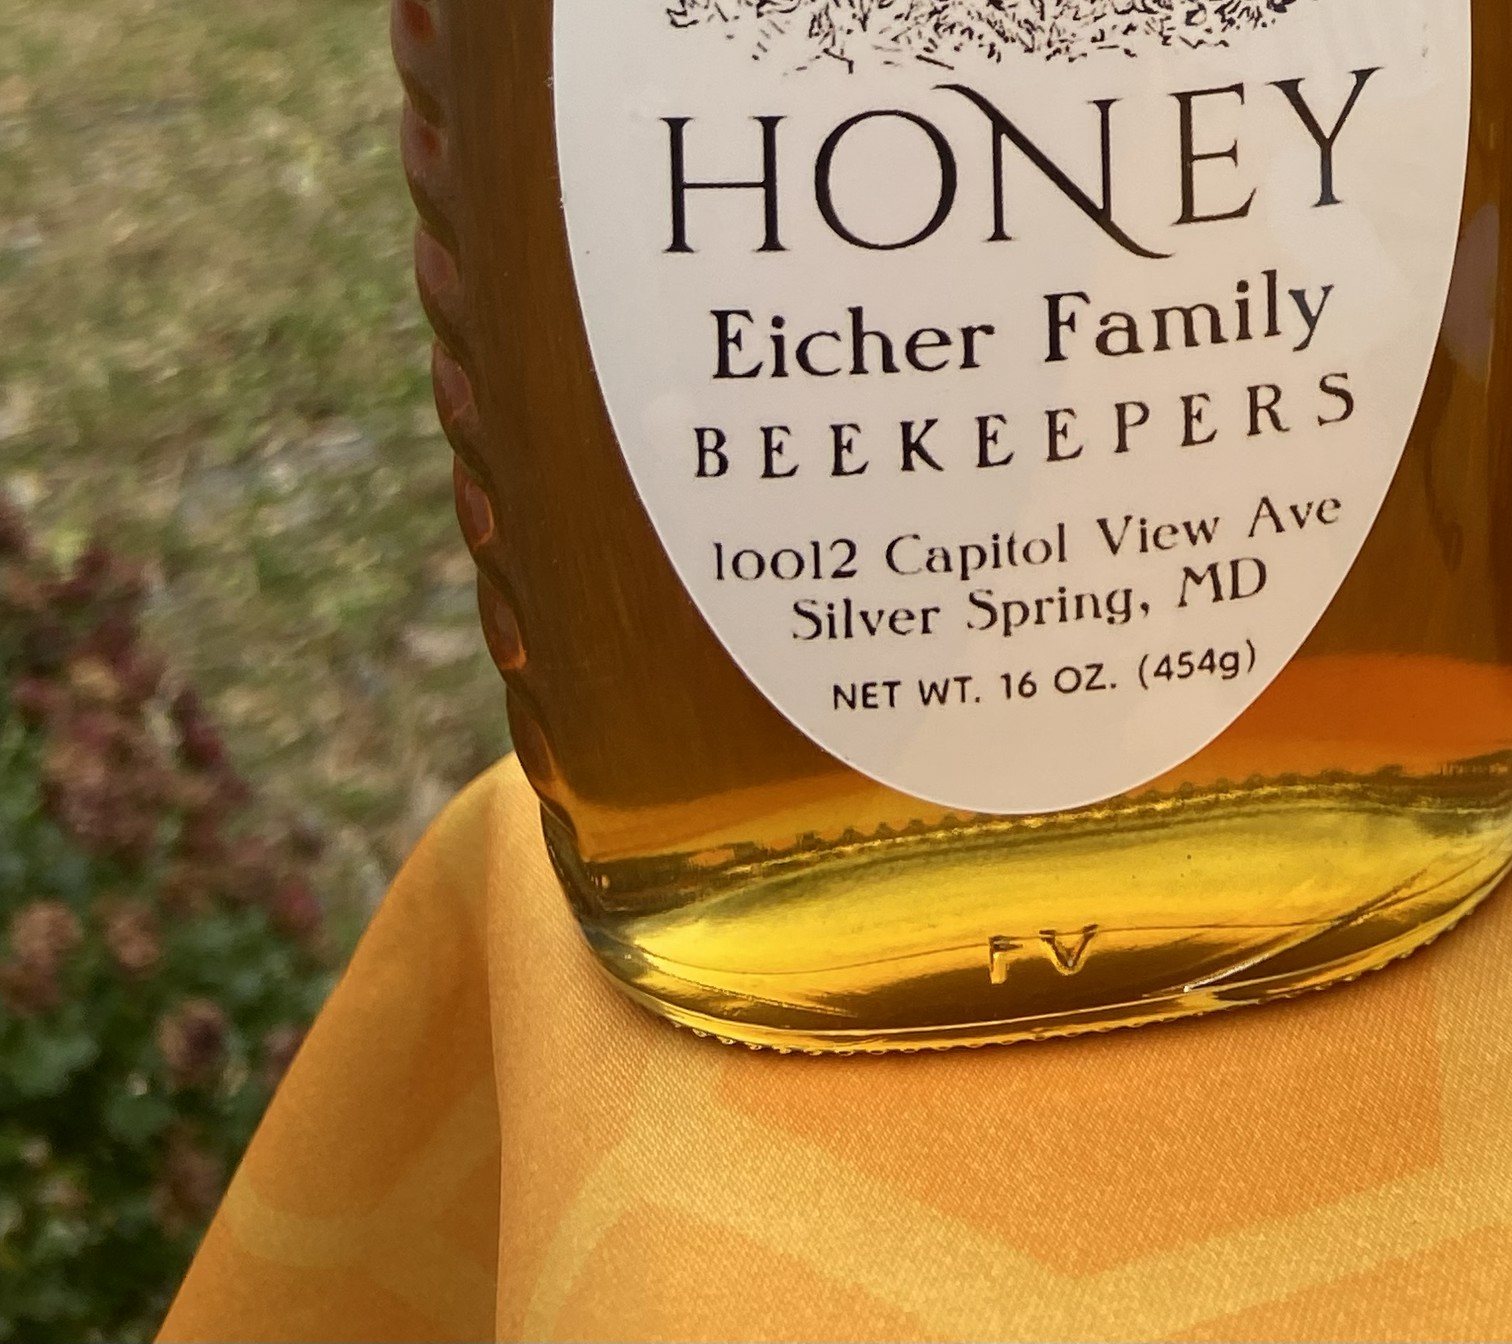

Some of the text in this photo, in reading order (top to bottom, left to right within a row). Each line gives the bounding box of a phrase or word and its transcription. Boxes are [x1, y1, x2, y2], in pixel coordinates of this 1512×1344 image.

[658, 65, 1382, 261] HONEY
[708, 268, 1336, 381] Eicher Family
[692, 371, 1355, 480] BEEKEEPERS
[712, 495, 1343, 583] 10012 Capitol View Ave
[791, 557, 1268, 642] Silver Spring, MD
[832, 638, 1257, 712] NET WT. 16 OZ. (454g)
